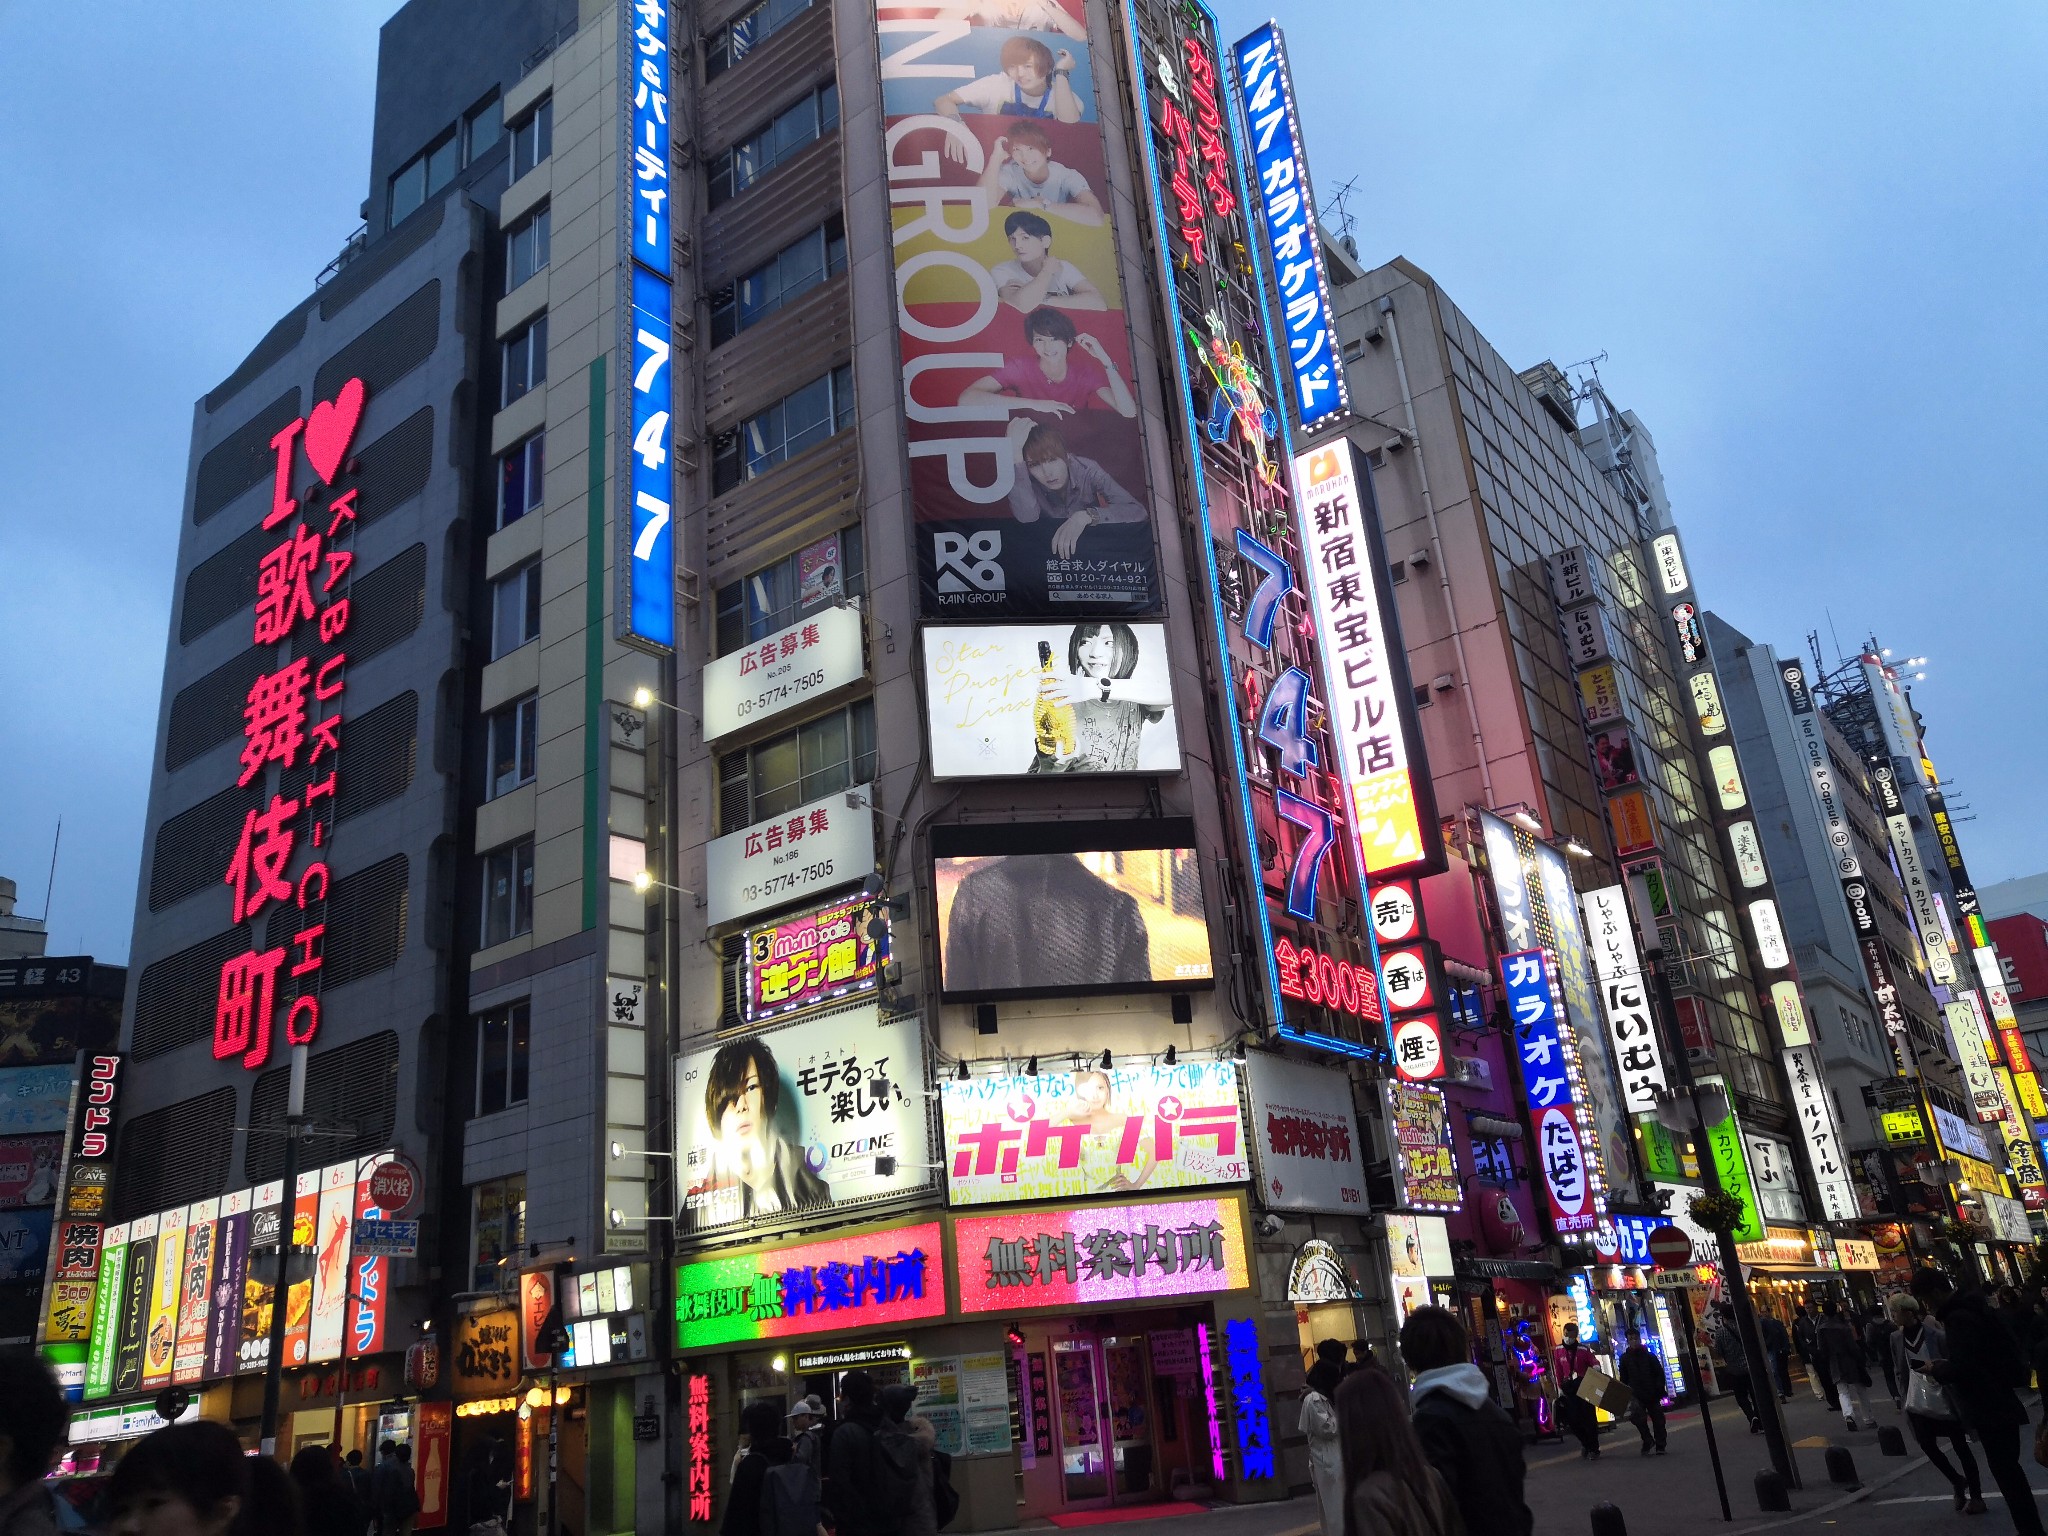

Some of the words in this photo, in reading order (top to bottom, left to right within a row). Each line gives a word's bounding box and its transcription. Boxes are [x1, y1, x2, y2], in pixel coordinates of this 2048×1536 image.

[885, 114, 1016, 506] GROUP
[633, 327, 670, 562] 747
[262, 417, 304, 531] I
[1046, 559, 1146, 573] 総合求人ダイヤル
[1065, 573, 1148, 584] 0120-744-921
[1560, 550, 1585, 600] 川新ビル
[1661, 546, 1682, 588] 東京ビル
[938, 594, 966, 605] RAIN
[968, 592, 1007, 604] GROUP
[739, 623, 820, 676] 広告募集
[936, 639, 1005, 674] Star
[1313, 494, 1396, 776] 新宿東宝ビル店
[1575, 611, 1598, 658] にいむら
[737, 668, 825, 718] 03-5774-7505
[766, 663, 792, 680] No.205
[943, 651, 1061, 705] Project
[1783, 667, 1808, 711] Booth
[1235, 527, 1335, 922] 747
[286, 488, 359, 1045] KABUKI-CHO
[1801, 719, 1813, 736] Net
[1808, 740, 1821, 768] Cafe
[1820, 781, 1840, 827] Capsule
[1874, 766, 1898, 809] Booth
[213, 523, 322, 1070] 歌舞伎町
[744, 808, 829, 859] 広告募集
[773, 849, 799, 866] No.186
[1894, 821, 1918, 873] ネットカフェ
[1914, 889, 1935, 926] カプセル
[742, 859, 834, 903] 03-5774-7505
[1375, 900, 1400, 926] 売
[1401, 903, 1413, 915] た
[1846, 882, 1872, 930] Booth
[1597, 896, 1627, 979] しゃぶしゃぶ
[56, 968, 81, 984] 43
[761, 938, 858, 1004] 逆ナン館
[1387, 966, 1411, 993] 香
[1412, 969, 1425, 982] ば
[1509, 957, 1566, 1107] カラオケ
[1874, 984, 1907, 1036] 甘太郎
[1400, 1036, 1425, 1063] 煙
[1426, 1040, 1438, 1053] こ
[1609, 984, 1663, 1102] にいむら
[797, 1056, 891, 1097] モテるって
[1403, 1059, 1436, 1072] CIGARETTE
[1791, 1053, 1812, 1099] 喫茶室
[82, 1056, 119, 1157] ゴンドラ
[1888, 1118, 1919, 1131] ロード
[1981, 1110, 2000, 1122] B1
[831, 1132, 896, 1158] OZONE
[952, 1095, 1238, 1178] ポケパラ
[1804, 1103, 1839, 1175] ルノアール
[73, 1165, 107, 1181] CAVE
[332, 1168, 344, 1185] 6F
[1408, 1146, 1453, 1180] 逆ナン館
[1544, 1122, 1581, 1202] たばこ
[2009, 1137, 2043, 1183] 金の蔵
[230, 1195, 241, 1213] 3F
[263, 1187, 274, 1203] 4F
[297, 1177, 308, 1194] 5F
[373, 1177, 410, 1197] 消火栓
[1826, 1184, 1843, 1220] 磯丸水産
[137, 1219, 152, 1237] B1F
[165, 1211, 182, 1230] M2F
[199, 1205, 209, 1221] 2F
[253, 1212, 280, 1237] CAVE
[372, 1221, 417, 1239] セキネ
[1555, 1213, 1594, 1232] 直売所
[63, 1223, 99, 1269] 焼肉
[109, 1227, 123, 1245] B2F
[222, 1219, 234, 1281] DREAM
[985, 1219, 1225, 1289] 無料案内所
[189, 1222, 212, 1301] 焼肉
[1657, 1271, 1697, 1285] 自転車を除く
[56, 1284, 91, 1302] 300
[129, 1254, 145, 1338] nest
[231, 1256, 243, 1328] イベントスペース
[676, 1247, 928, 1322] 歌舞伎町無料案内所
[213, 1309, 225, 1374] STORE
[687, 1374, 711, 1521] 無料案内所
